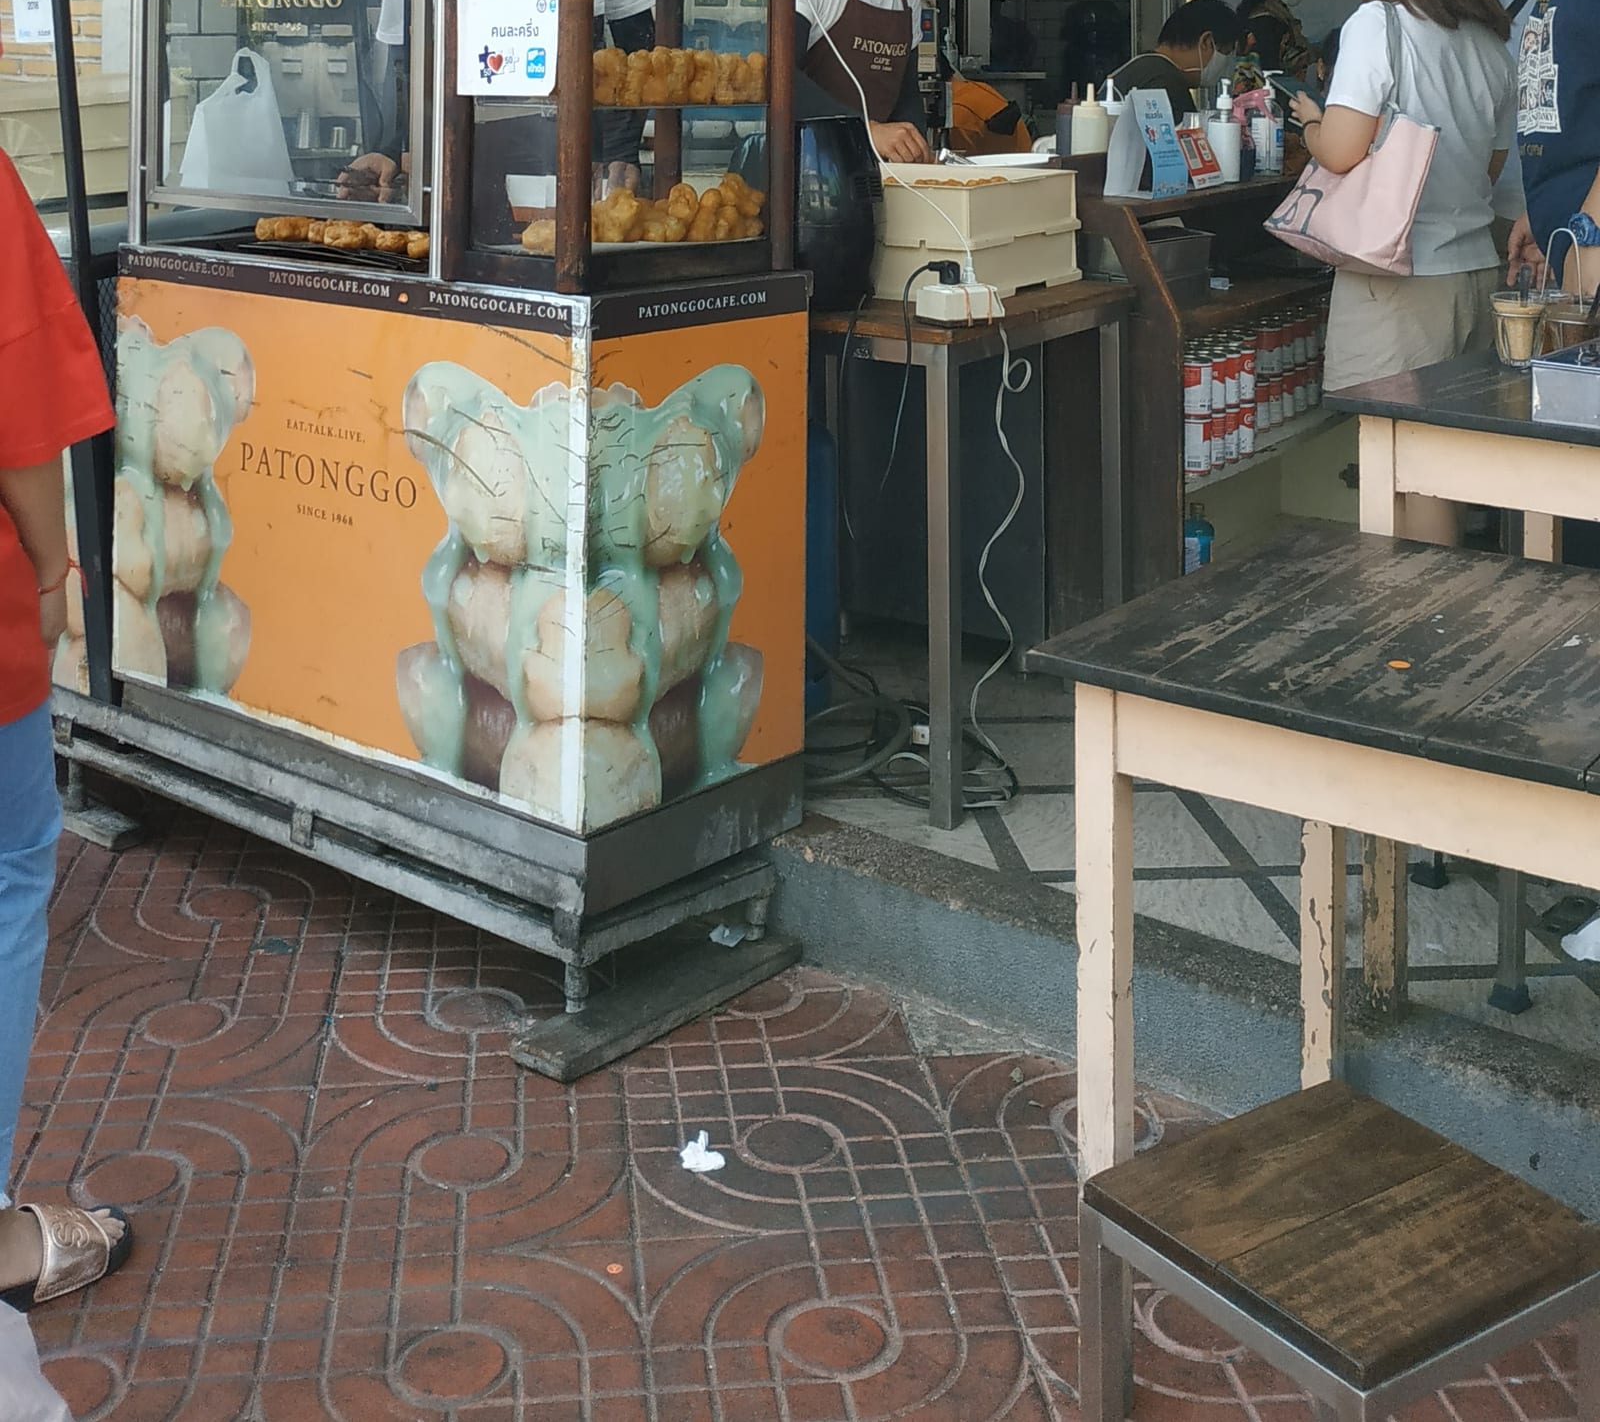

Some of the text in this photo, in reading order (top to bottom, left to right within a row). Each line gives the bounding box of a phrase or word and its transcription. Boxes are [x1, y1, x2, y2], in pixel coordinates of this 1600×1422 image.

[491, 18, 539, 37] คนละครึ่ง
[505, 56, 513, 64] 50
[128, 254, 568, 321] PATONGGOCAFE.COM PATONGGOCAFE.COM PATONGGOCAFE.COM
[638, 291, 767, 319] PATONGGOCAFE.COM
[286, 419, 366, 443] EAT.TALK.LIVE.
[240, 442, 416, 509] PATONGGO
[296, 504, 327, 520] SINCE
